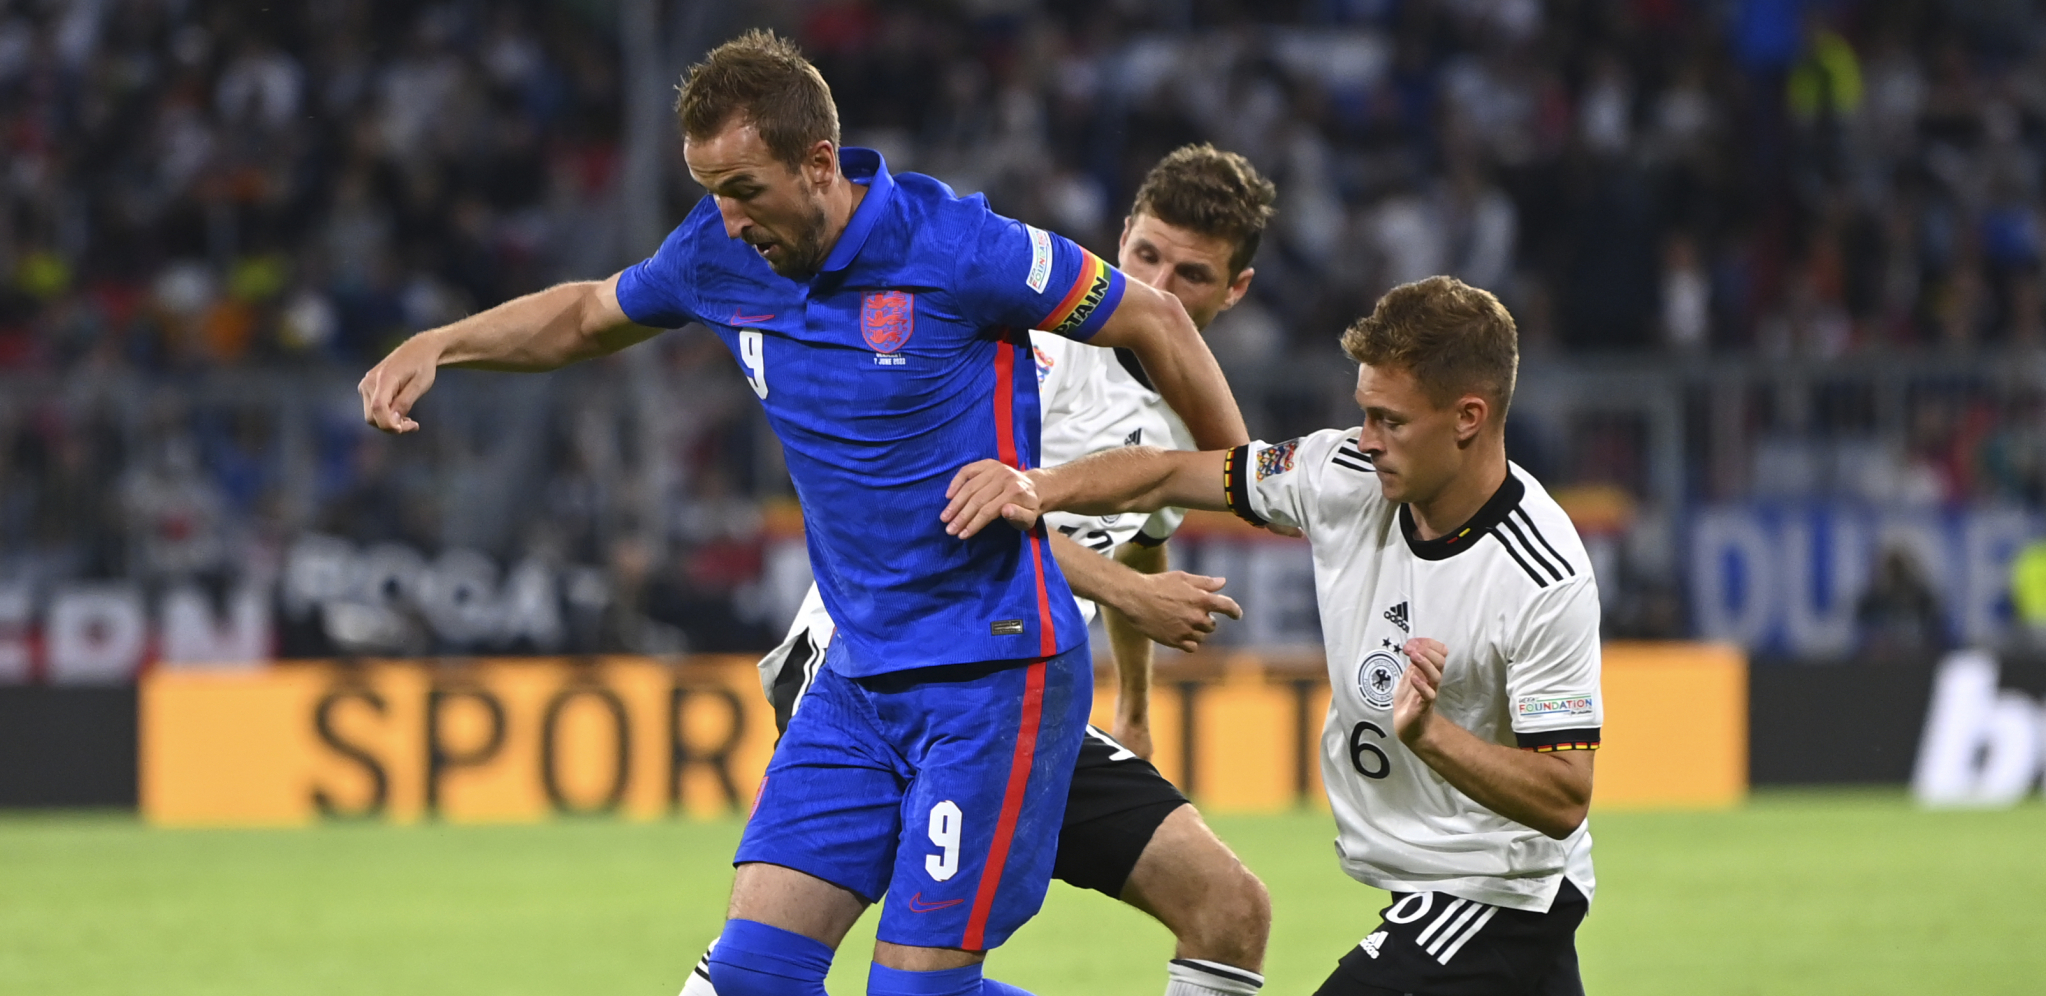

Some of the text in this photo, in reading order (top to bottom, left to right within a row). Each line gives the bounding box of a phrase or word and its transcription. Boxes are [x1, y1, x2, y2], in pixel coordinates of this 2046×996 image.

[739, 328, 769, 400] 9
[878, 357, 892, 366] JUNE
[1518, 698, 1593, 713] FOUNDATION
[1913, 650, 2046, 810] b
[1350, 720, 1391, 780] 6
[925, 800, 963, 882] 9
